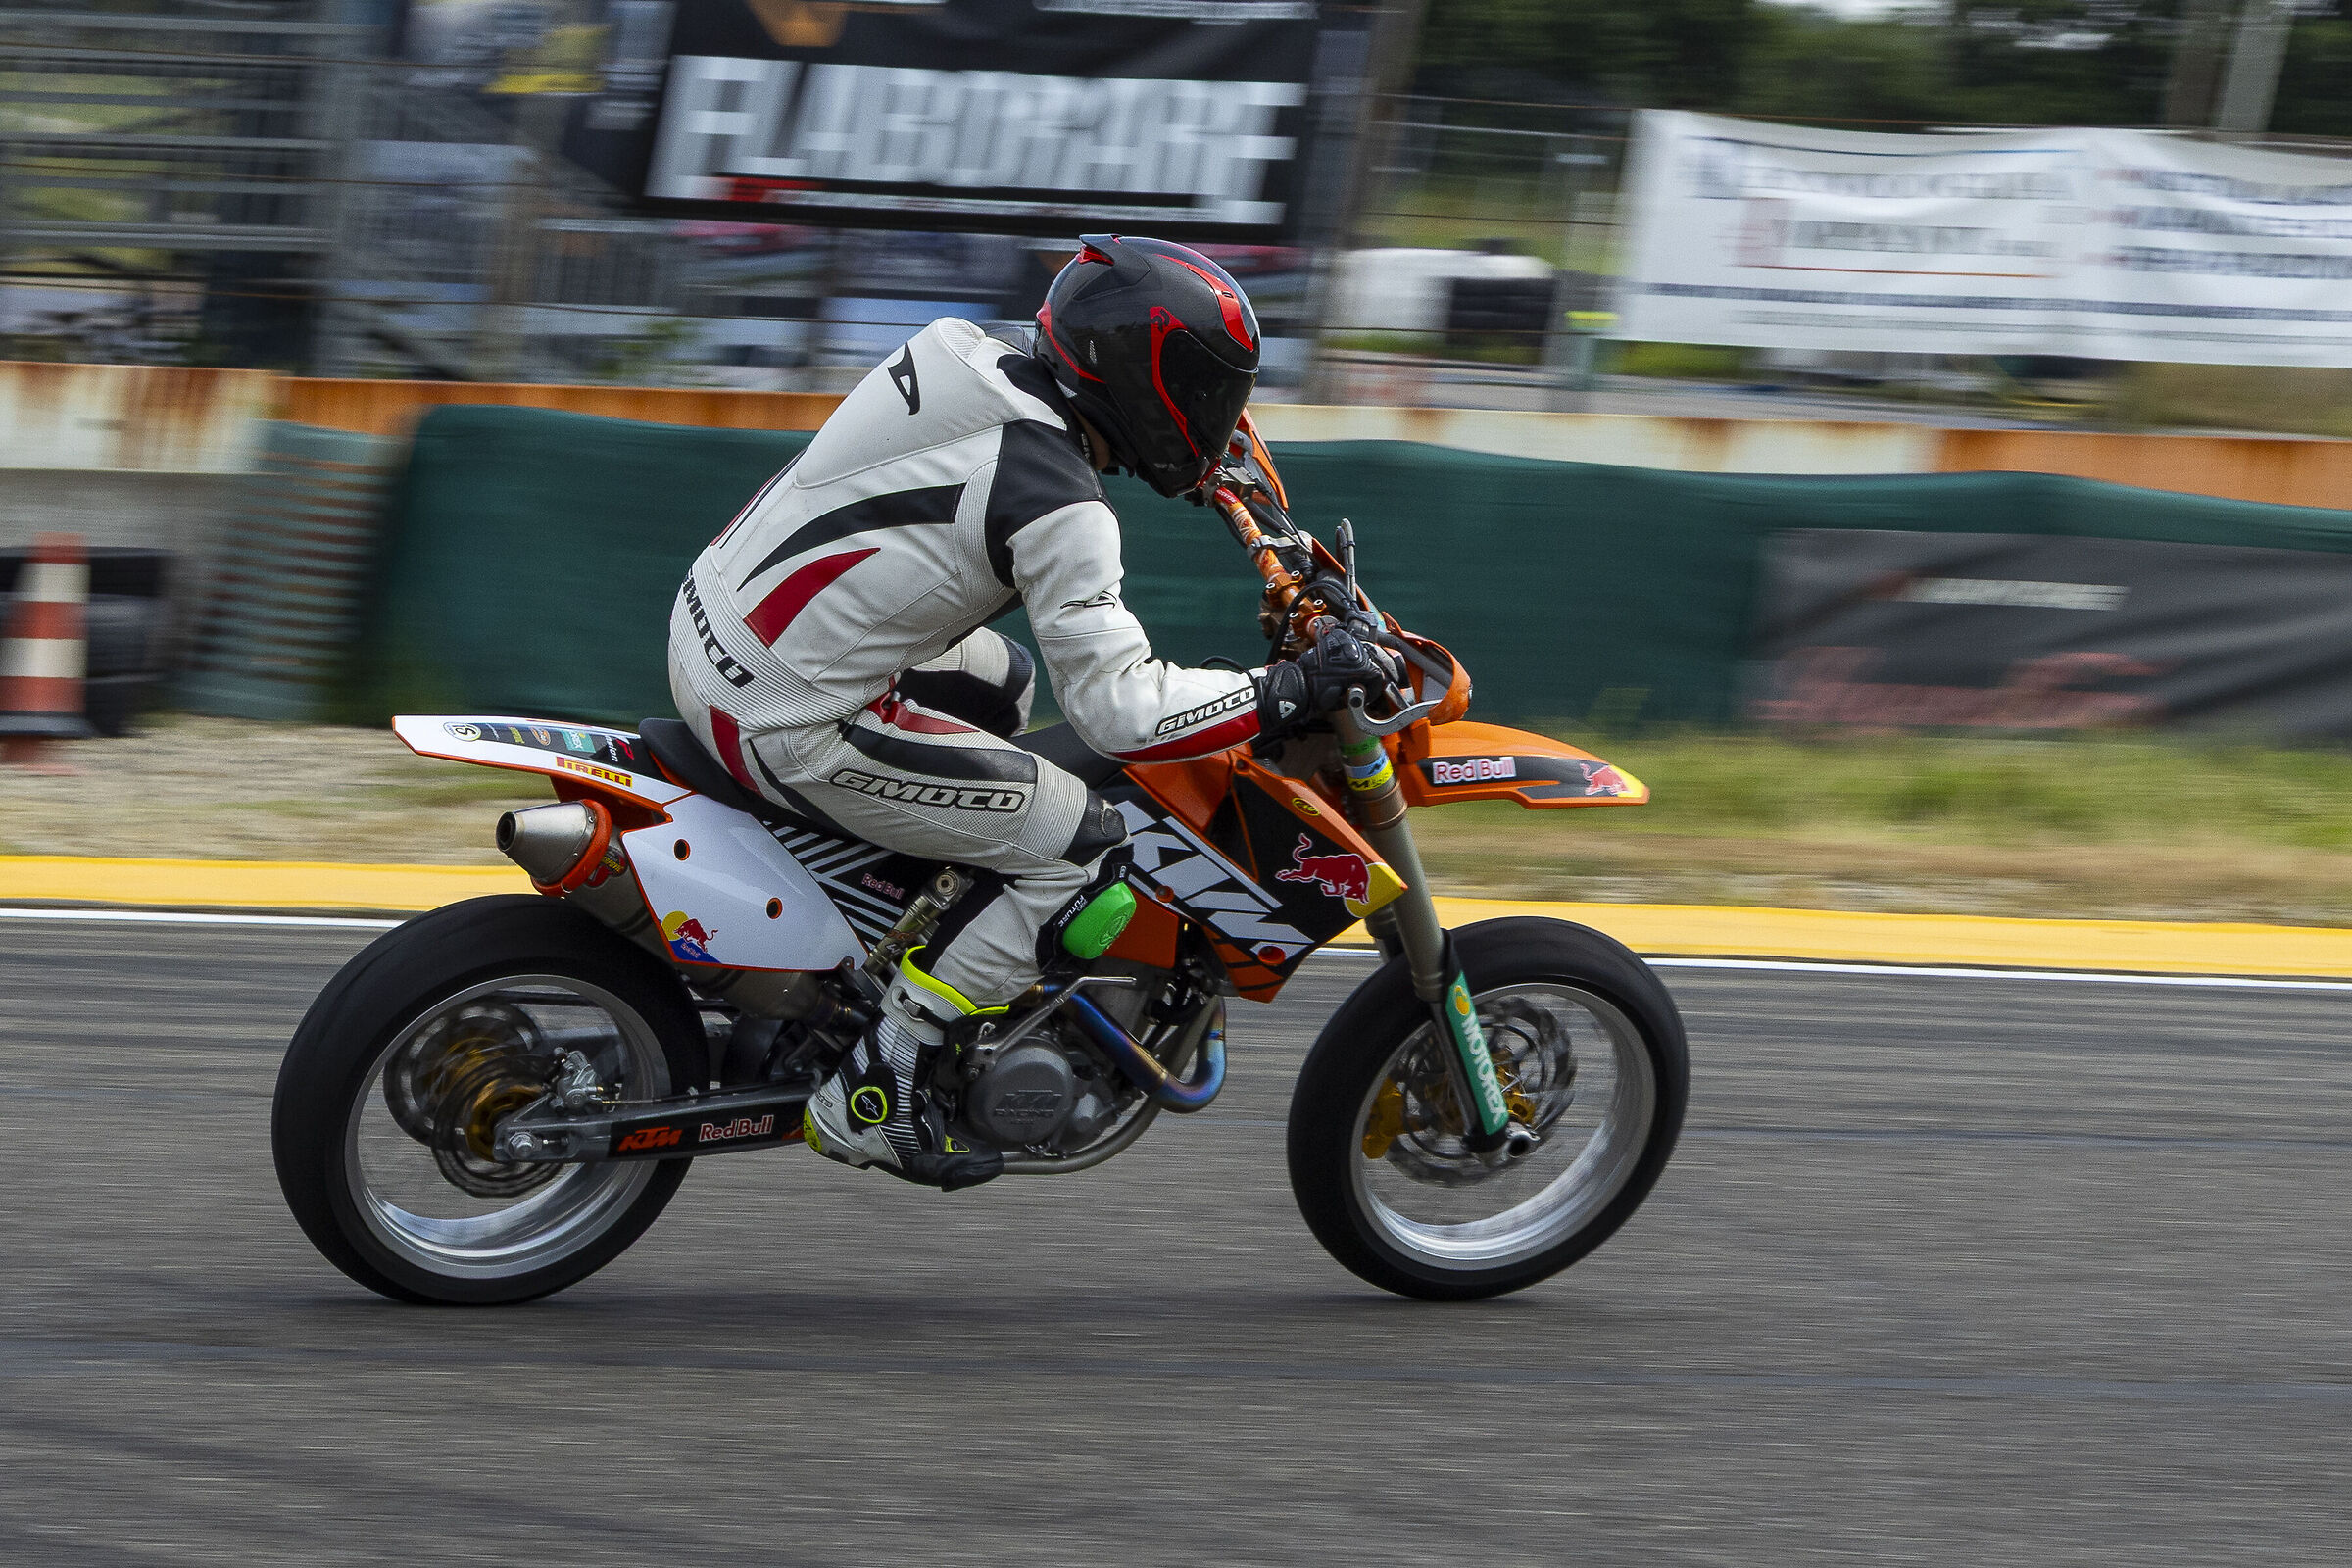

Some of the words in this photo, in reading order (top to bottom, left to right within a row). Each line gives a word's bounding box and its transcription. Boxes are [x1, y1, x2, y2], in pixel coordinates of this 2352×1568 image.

[1156, 686, 1256, 735] GIMOTO
[556, 756, 633, 788] PIRELLI
[1434, 761, 1473, 782] Red
[1480, 757, 1516, 778] Bull
[830, 769, 1024, 812] GIMOTO
[862, 873, 885, 892] Red
[1058, 895, 1085, 927] FUTURE
[1461, 1012, 1505, 1124] MOTOREX
[617, 1126, 683, 1152] KTM
[699, 1122, 736, 1142] Red
[736, 1114, 774, 1137] Bull
